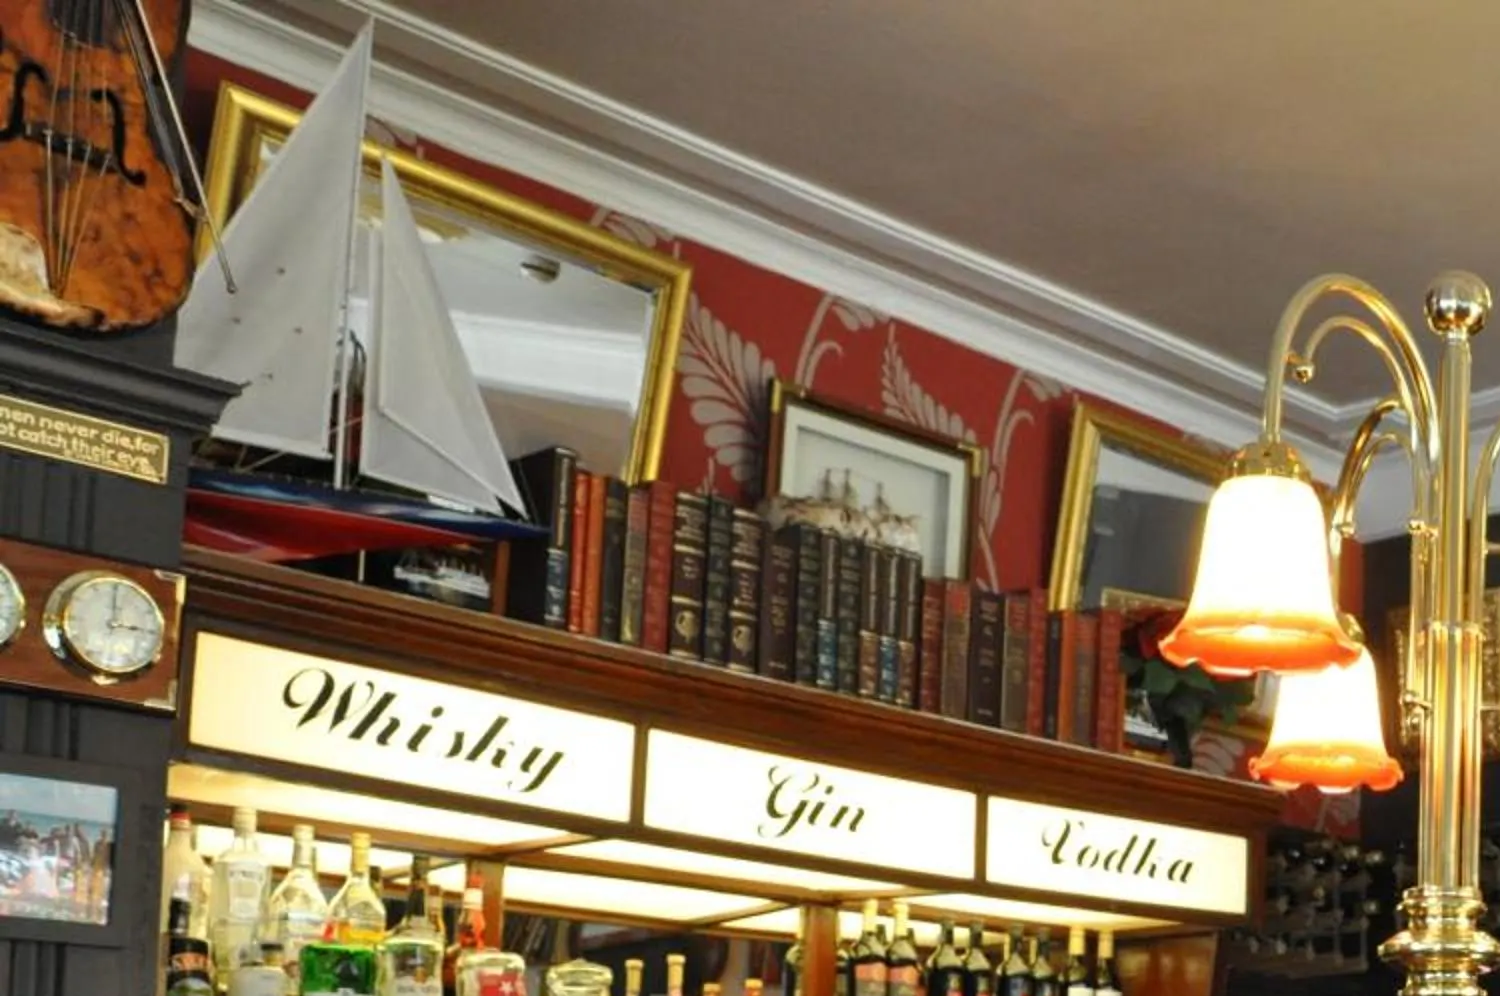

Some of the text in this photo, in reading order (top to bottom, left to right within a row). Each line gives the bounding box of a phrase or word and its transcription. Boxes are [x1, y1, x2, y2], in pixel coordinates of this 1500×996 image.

[0, 423, 17, 438] ot
[18, 427, 67, 449] catch
[71, 437, 115, 461] their
[39, 415, 99, 438] never
[282, 667, 565, 793] Whisky
[757, 764, 866, 839] Gin
[1041, 817, 1196, 885] Vodka
